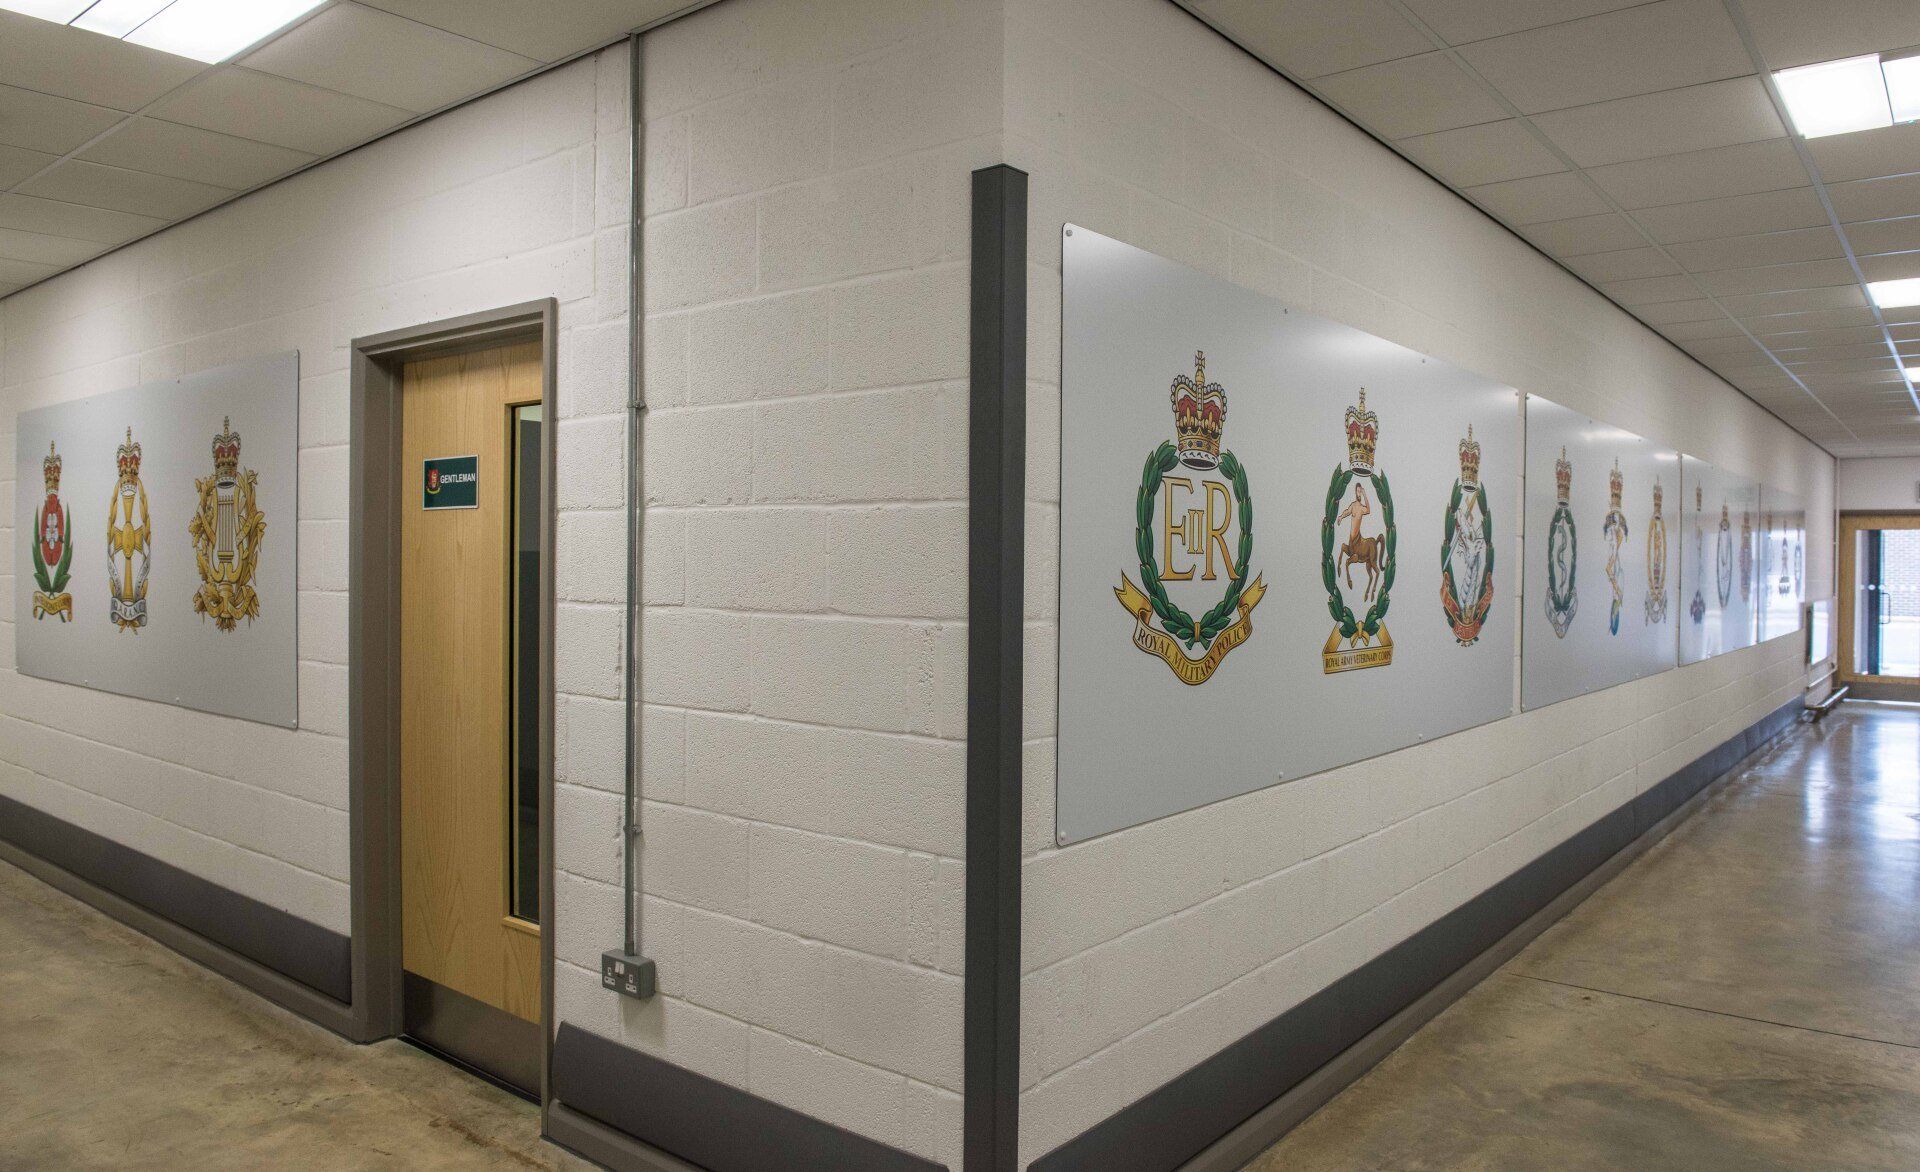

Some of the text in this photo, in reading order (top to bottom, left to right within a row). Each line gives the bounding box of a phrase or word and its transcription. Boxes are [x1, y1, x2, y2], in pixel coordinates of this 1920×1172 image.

[440, 473, 476, 483] GENTLEMAN
[1137, 621, 1251, 681] ROYAL MILITARY POLICE
[1326, 657, 1340, 668] ROYAL
[1341, 655, 1353, 666] ARMY
